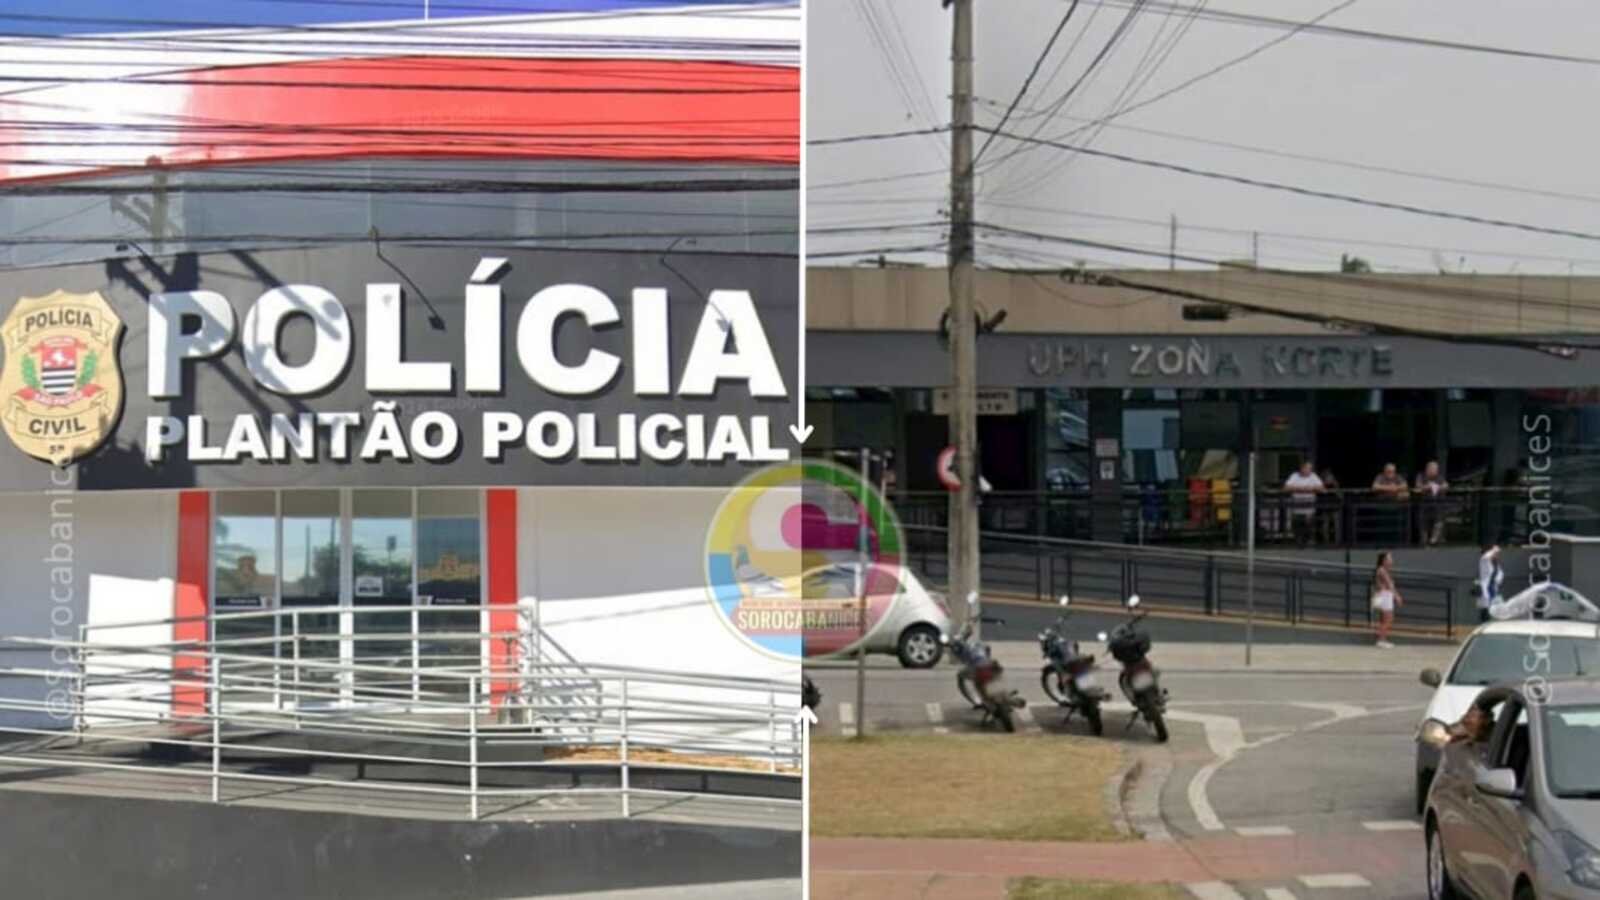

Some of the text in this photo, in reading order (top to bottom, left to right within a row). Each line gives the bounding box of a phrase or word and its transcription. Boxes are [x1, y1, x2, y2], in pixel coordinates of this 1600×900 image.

[147, 257, 788, 397] POLÍCIA
[28, 416, 87, 436] CIVIL
[146, 401, 790, 462] PLANTÃO POLICIAL
